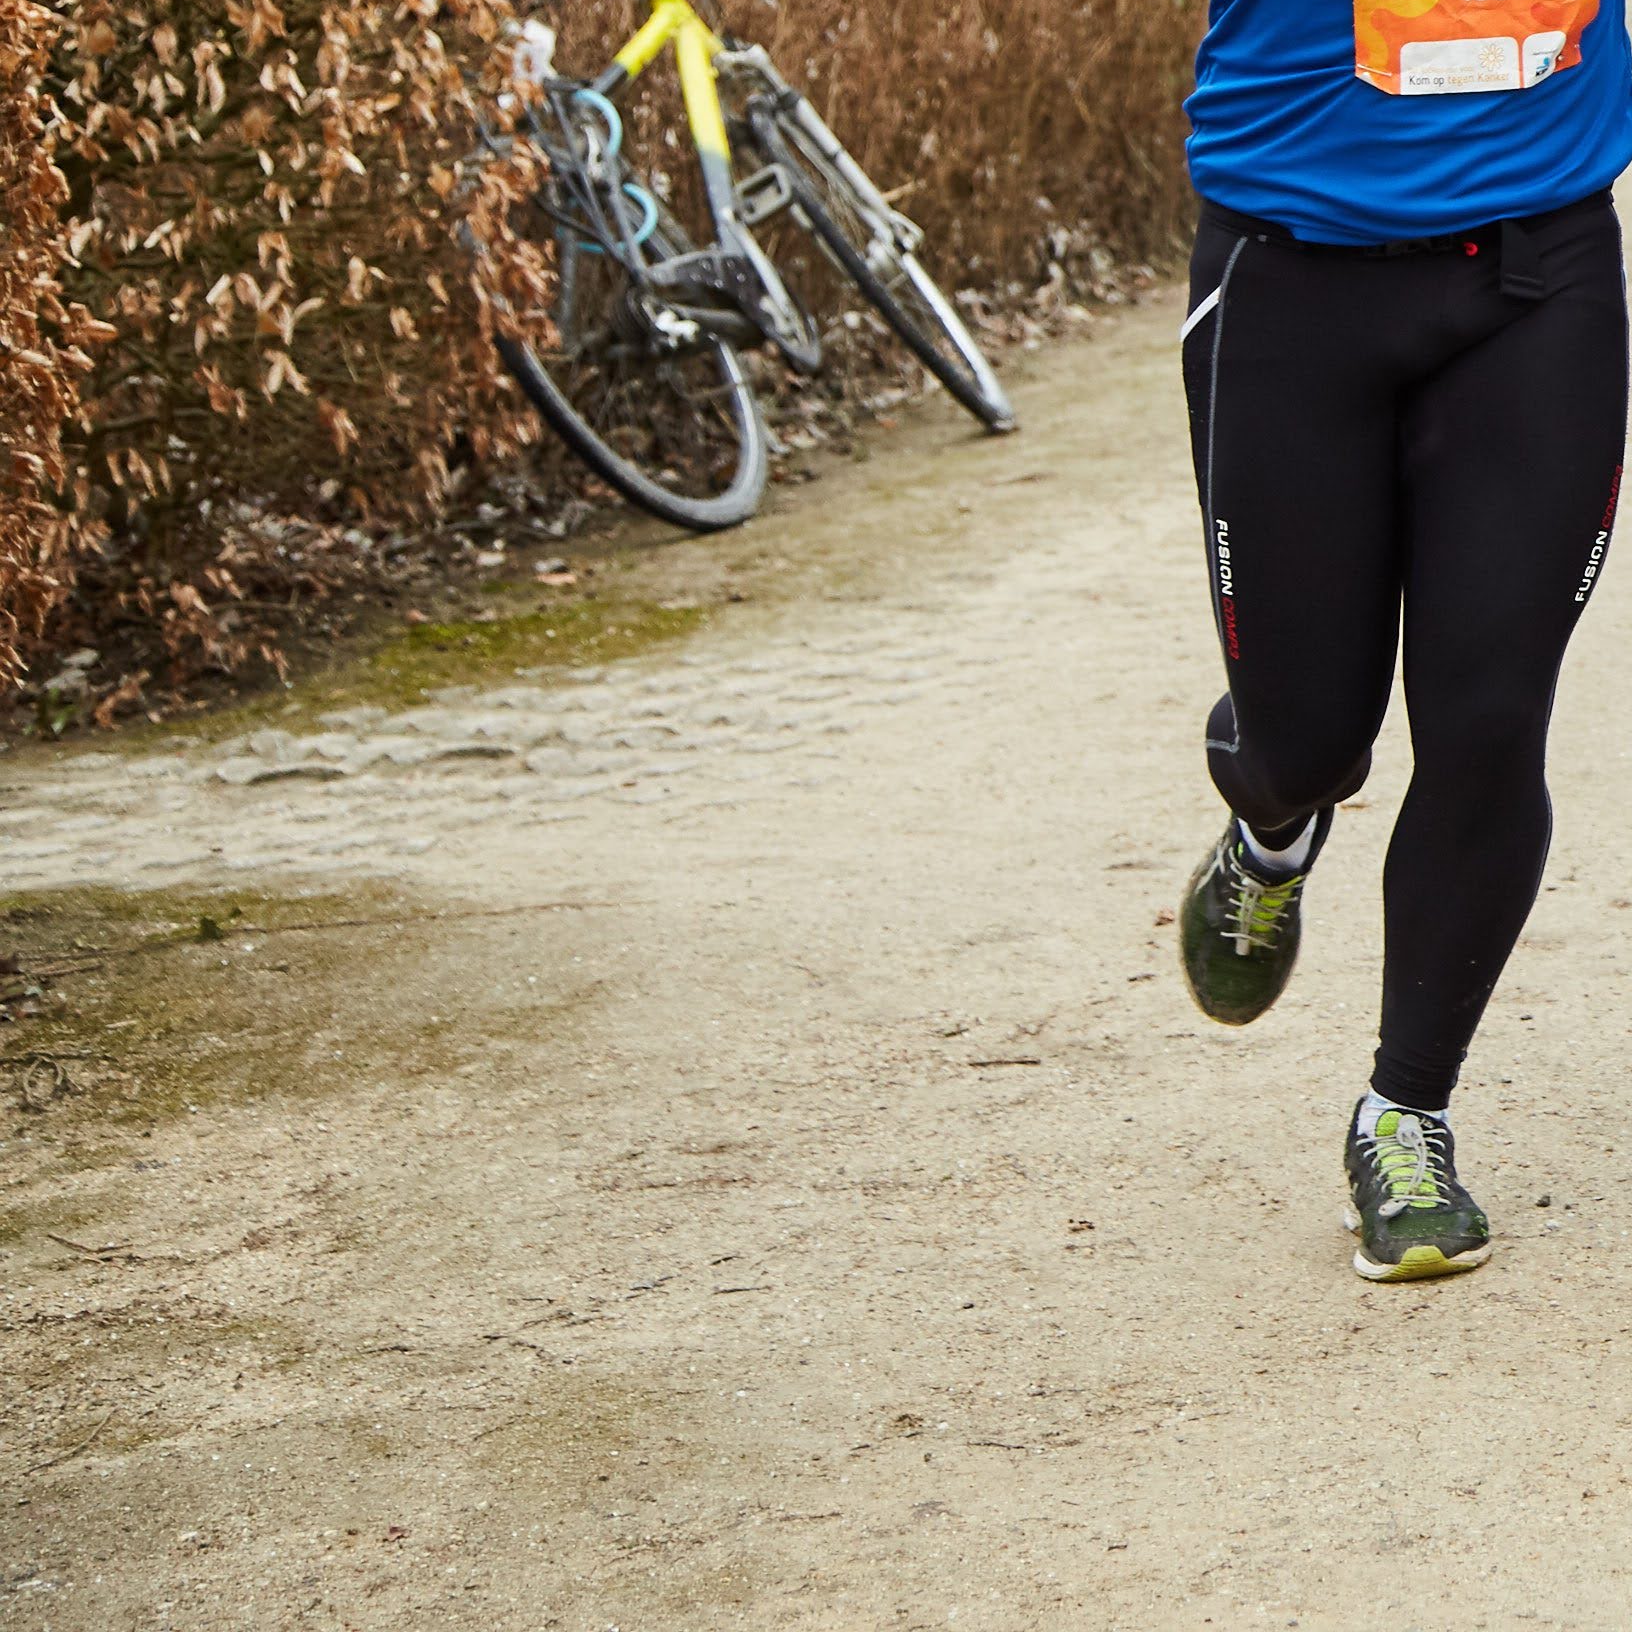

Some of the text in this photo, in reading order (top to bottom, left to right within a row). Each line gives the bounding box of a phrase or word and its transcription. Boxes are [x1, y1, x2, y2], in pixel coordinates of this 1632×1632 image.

[1409, 74, 1430, 86] Kom
[1433, 76, 1445, 88] op
[1216, 518, 1234, 596] FUSION
[1574, 530, 1607, 603] FUSION
